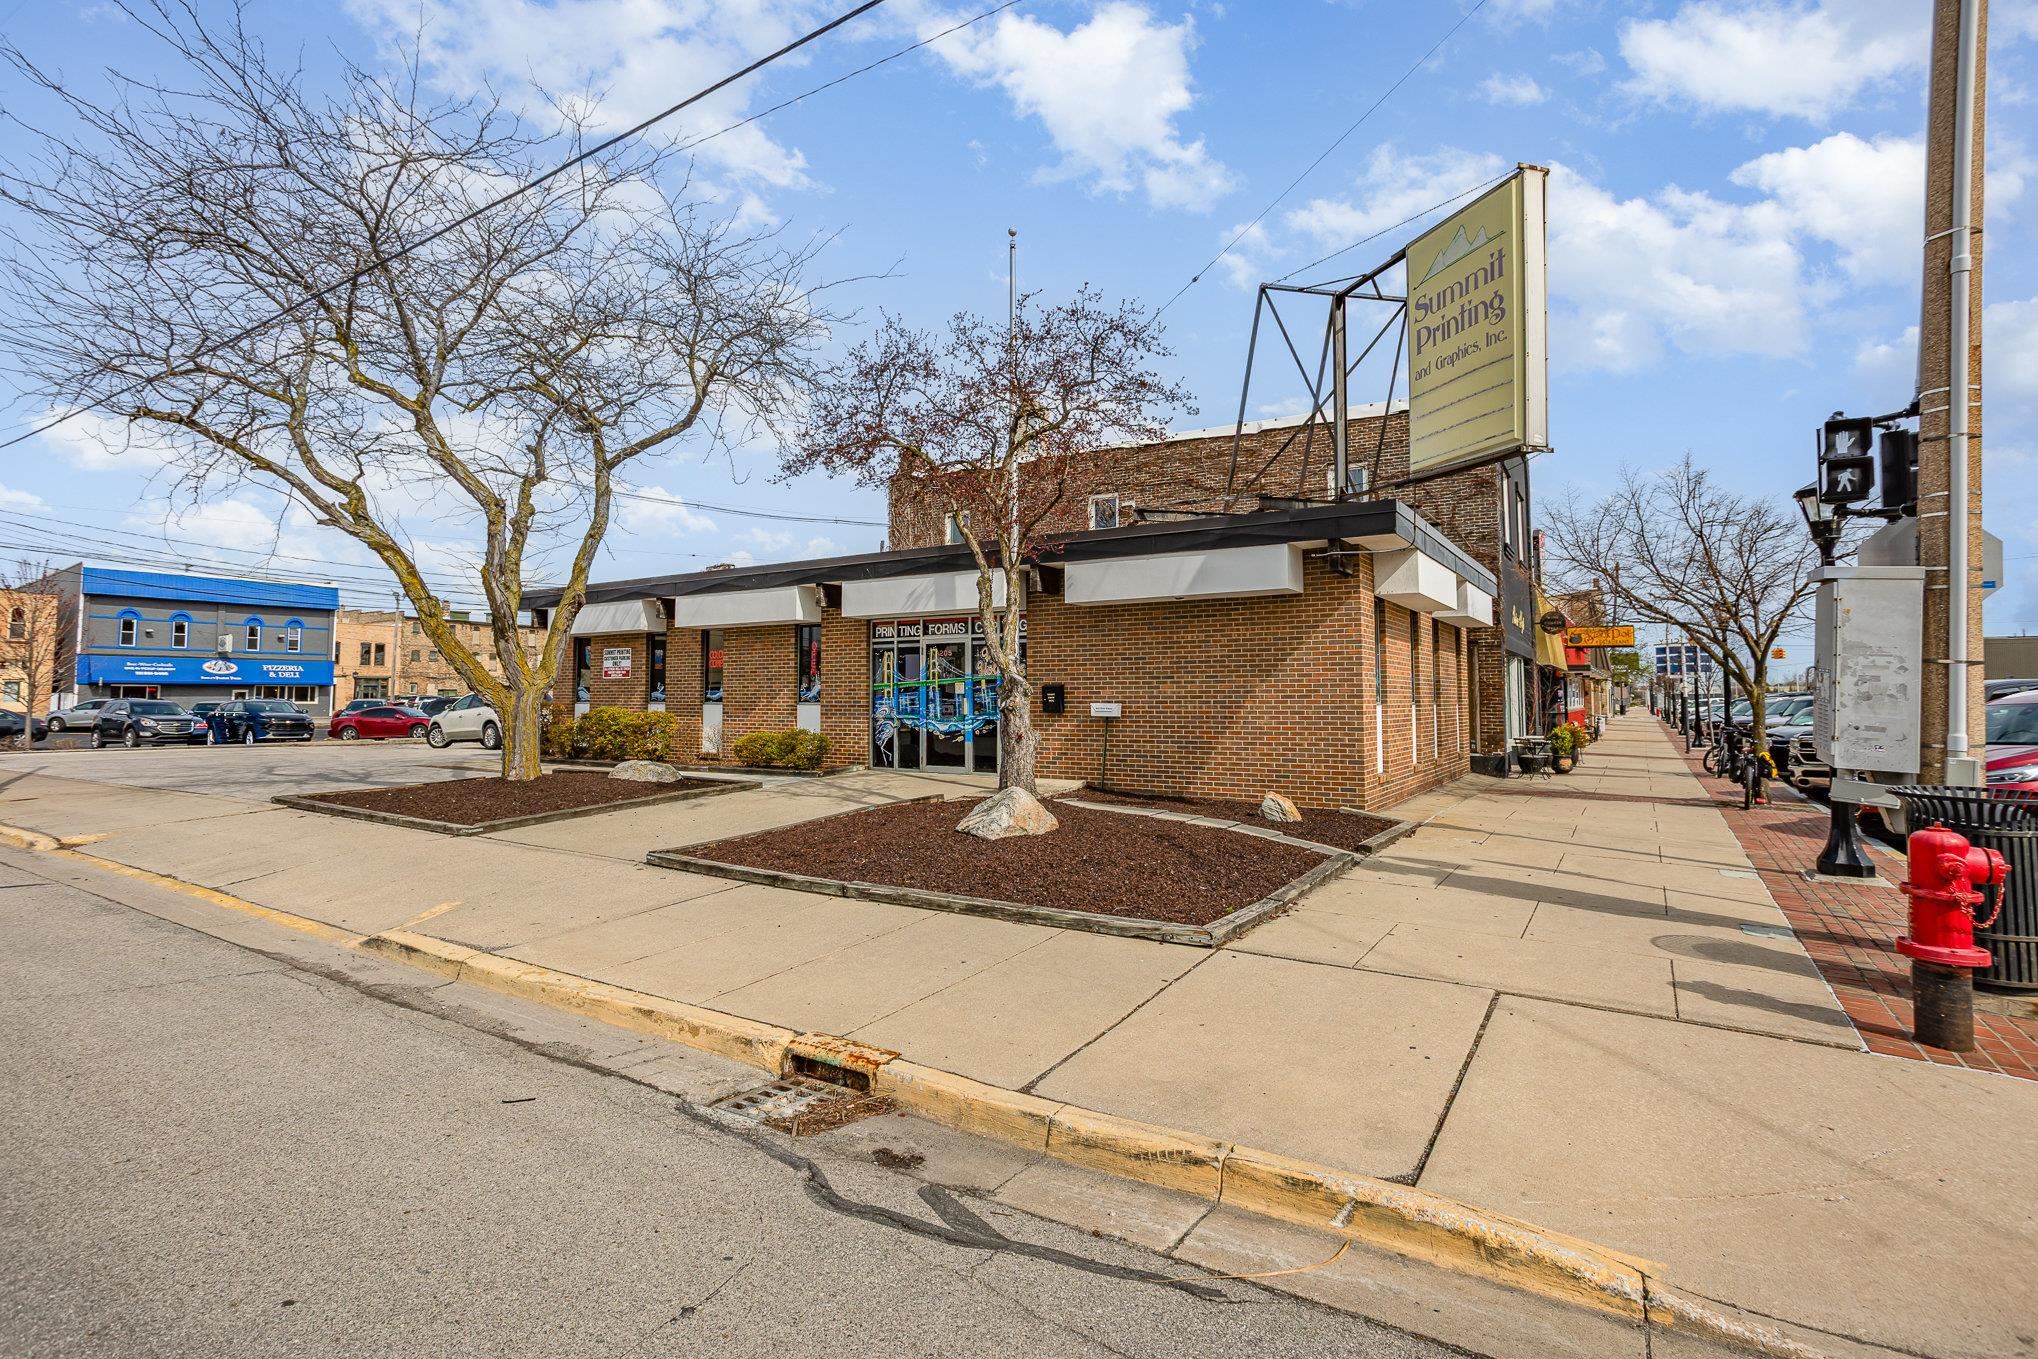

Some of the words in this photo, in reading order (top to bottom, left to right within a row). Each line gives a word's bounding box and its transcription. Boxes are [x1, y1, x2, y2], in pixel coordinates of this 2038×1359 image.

[1414, 248, 1506, 325] Summit
[1415, 289, 1506, 356] Printing
[1415, 361, 1431, 381] and
[1435, 340, 1482, 371] Graphics,
[1485, 329, 1508, 348] Inc.
[875, 625, 921, 638] PRINTING
[928, 622, 966, 635] FORMS
[262, 664, 304, 672] PIZZERIA
